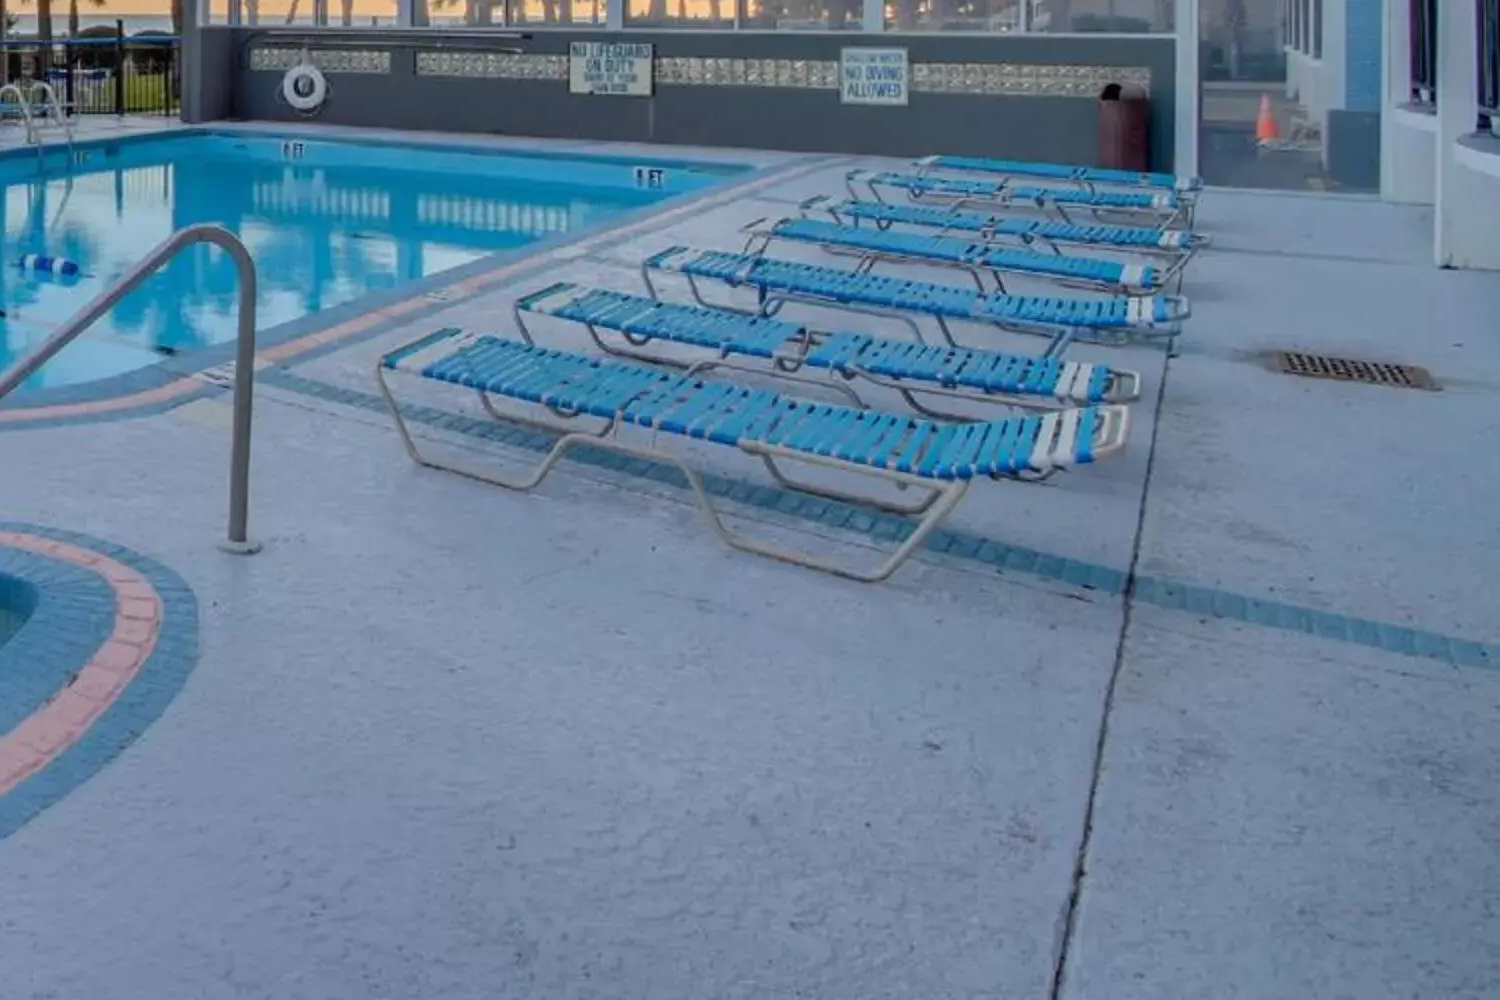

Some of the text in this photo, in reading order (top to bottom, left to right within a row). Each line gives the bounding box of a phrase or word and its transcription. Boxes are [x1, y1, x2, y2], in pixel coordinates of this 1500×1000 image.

[589, 45, 651, 59] LIFEGUARD
[604, 59, 635, 73] DUTY
[845, 66, 902, 80] NO DIVING
[846, 82, 901, 97] ALLOWED
